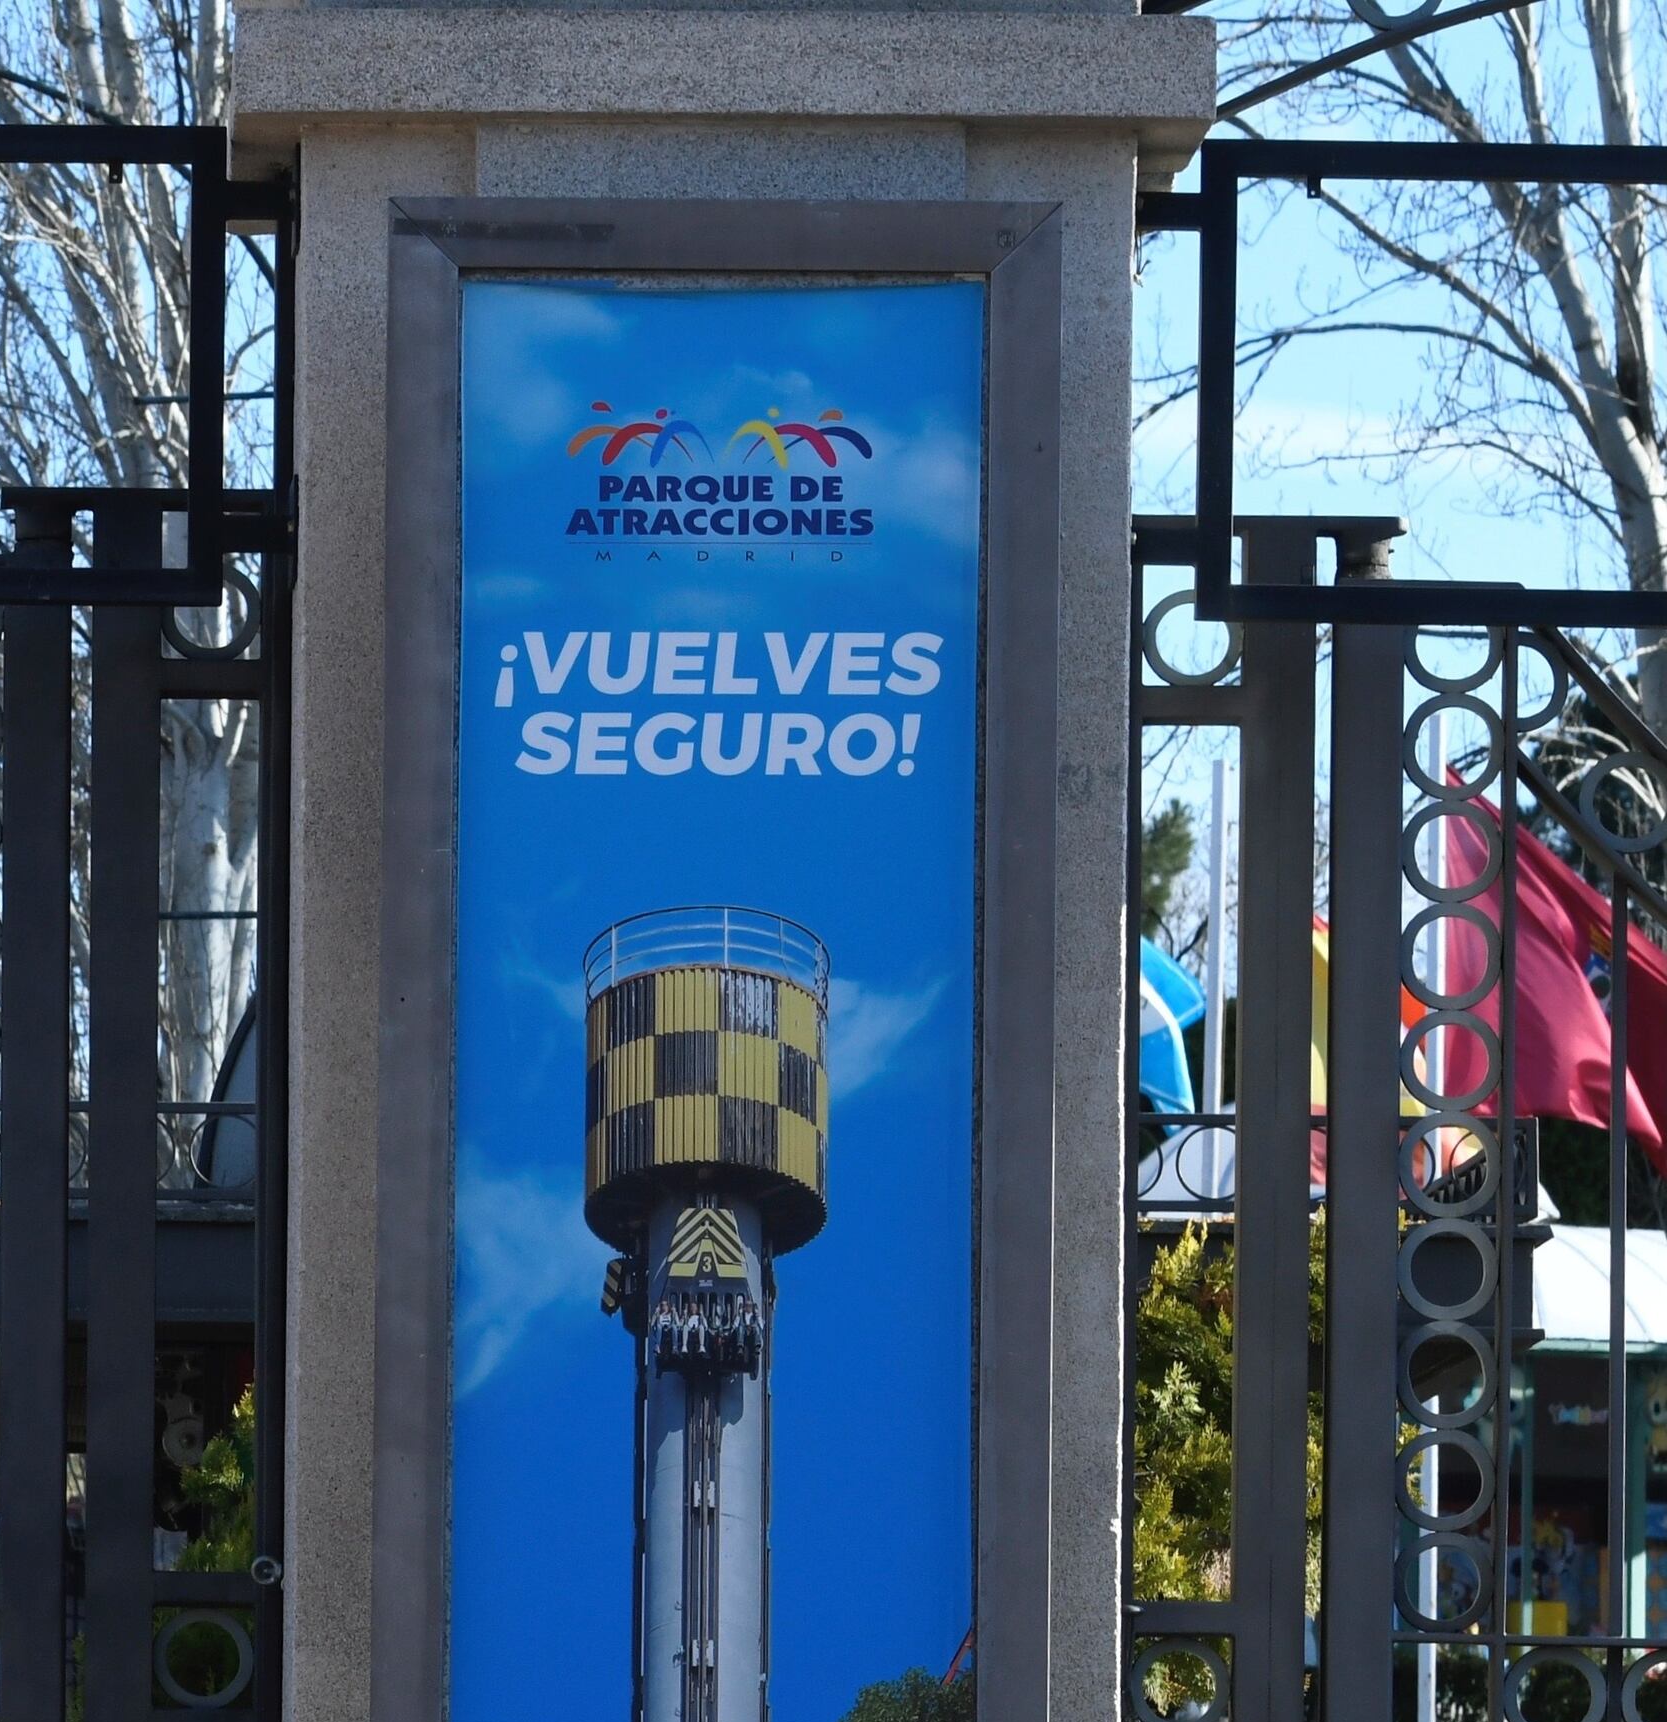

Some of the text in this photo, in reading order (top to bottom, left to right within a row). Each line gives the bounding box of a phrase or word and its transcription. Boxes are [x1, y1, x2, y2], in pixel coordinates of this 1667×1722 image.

[599, 475, 843, 506] PARQUE DE
[566, 507, 875, 536] ATRACCIONES
[595, 549, 843, 562] MADRID
[494, 631, 945, 707] ¡VUELVES
[514, 711, 922, 777] SEGURO!
[702, 1256, 713, 1273] 3
